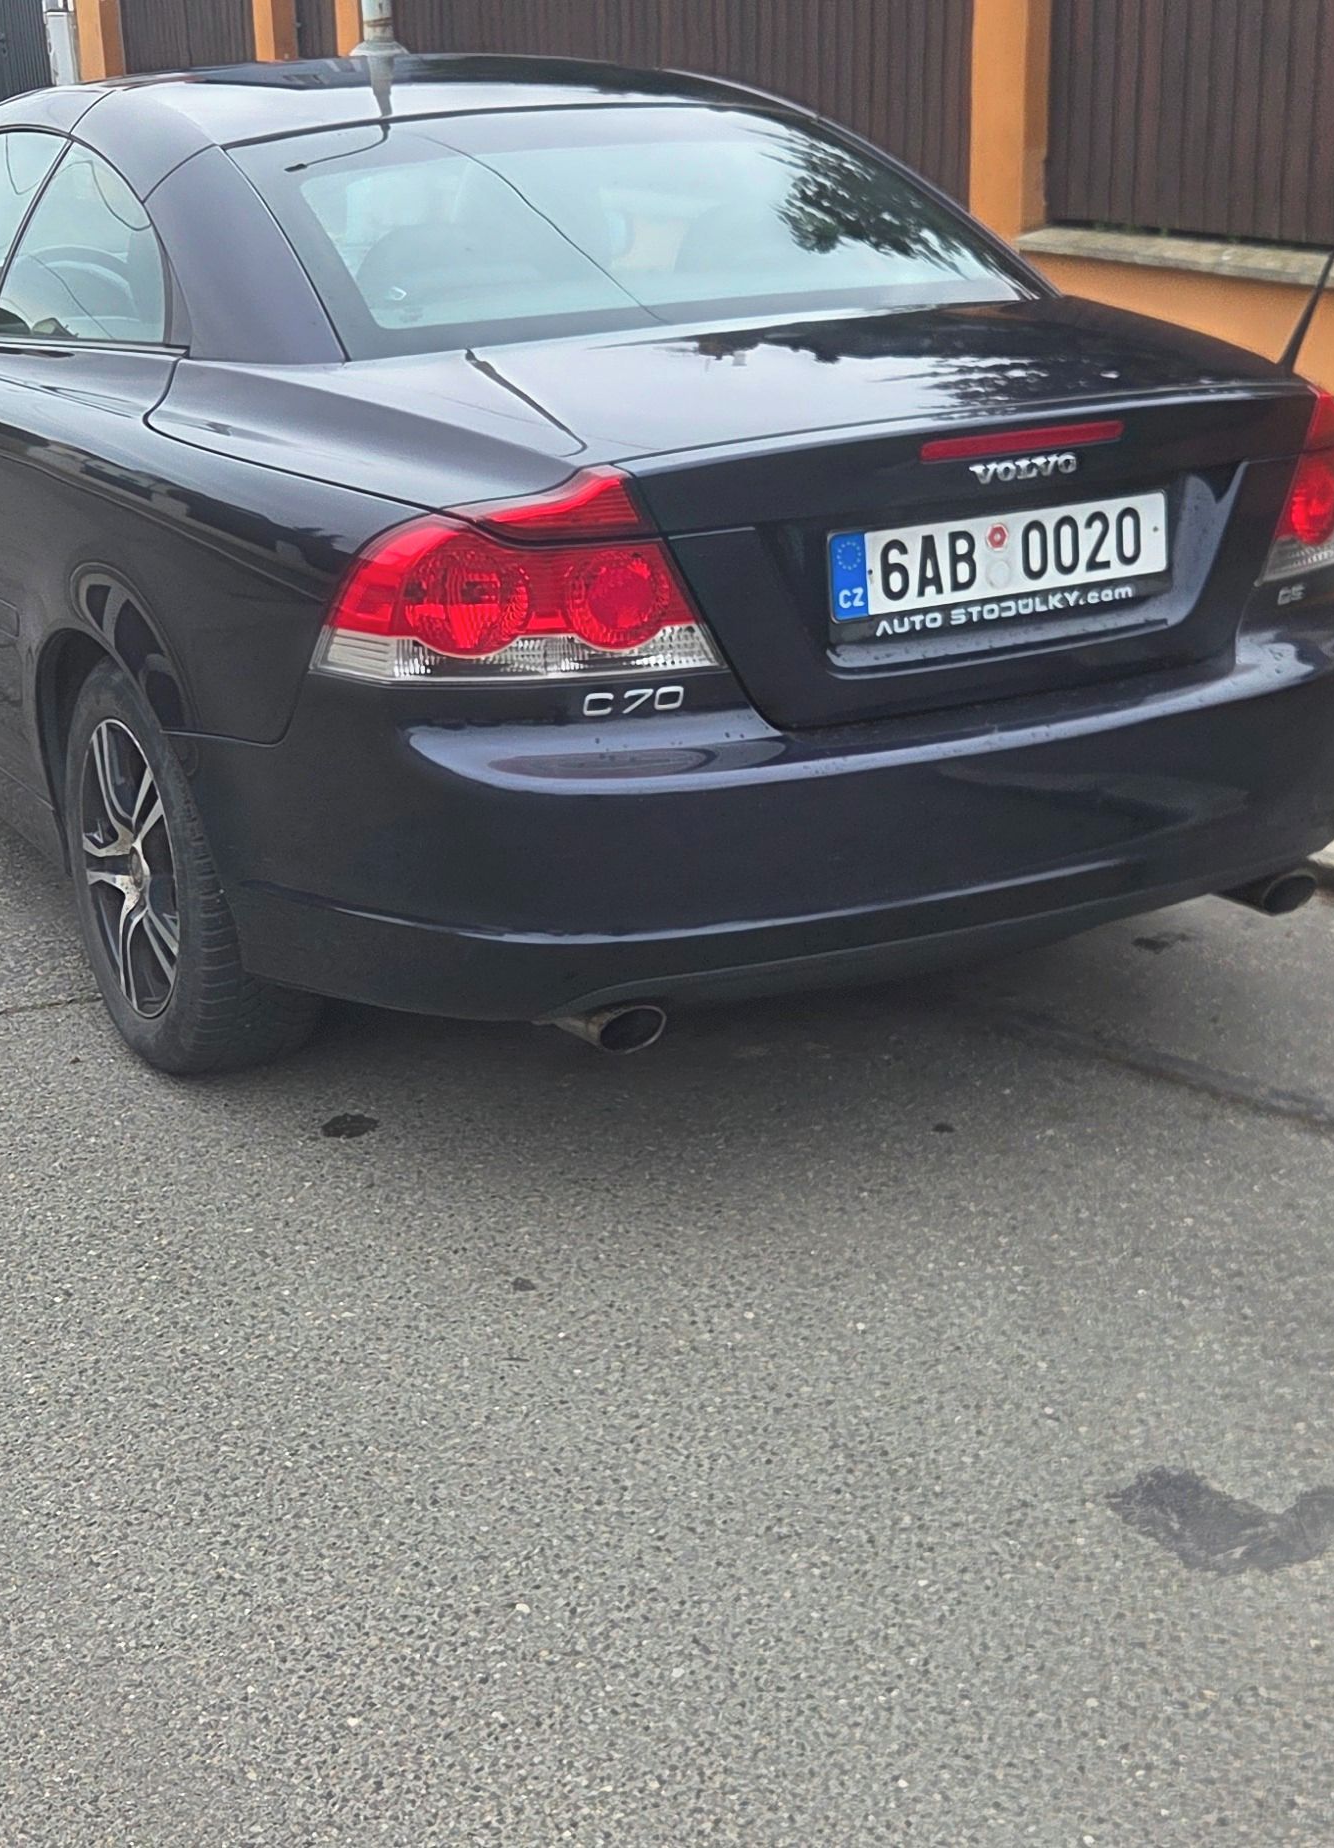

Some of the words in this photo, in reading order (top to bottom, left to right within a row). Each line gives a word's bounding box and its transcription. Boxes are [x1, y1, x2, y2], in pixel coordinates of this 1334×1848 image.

[968, 451, 1077, 485] VOLVO
[880, 530, 977, 601] 6AB
[1021, 506, 1142, 581] 0020
[838, 587, 865, 609] CZ
[875, 612, 943, 637] AUTO
